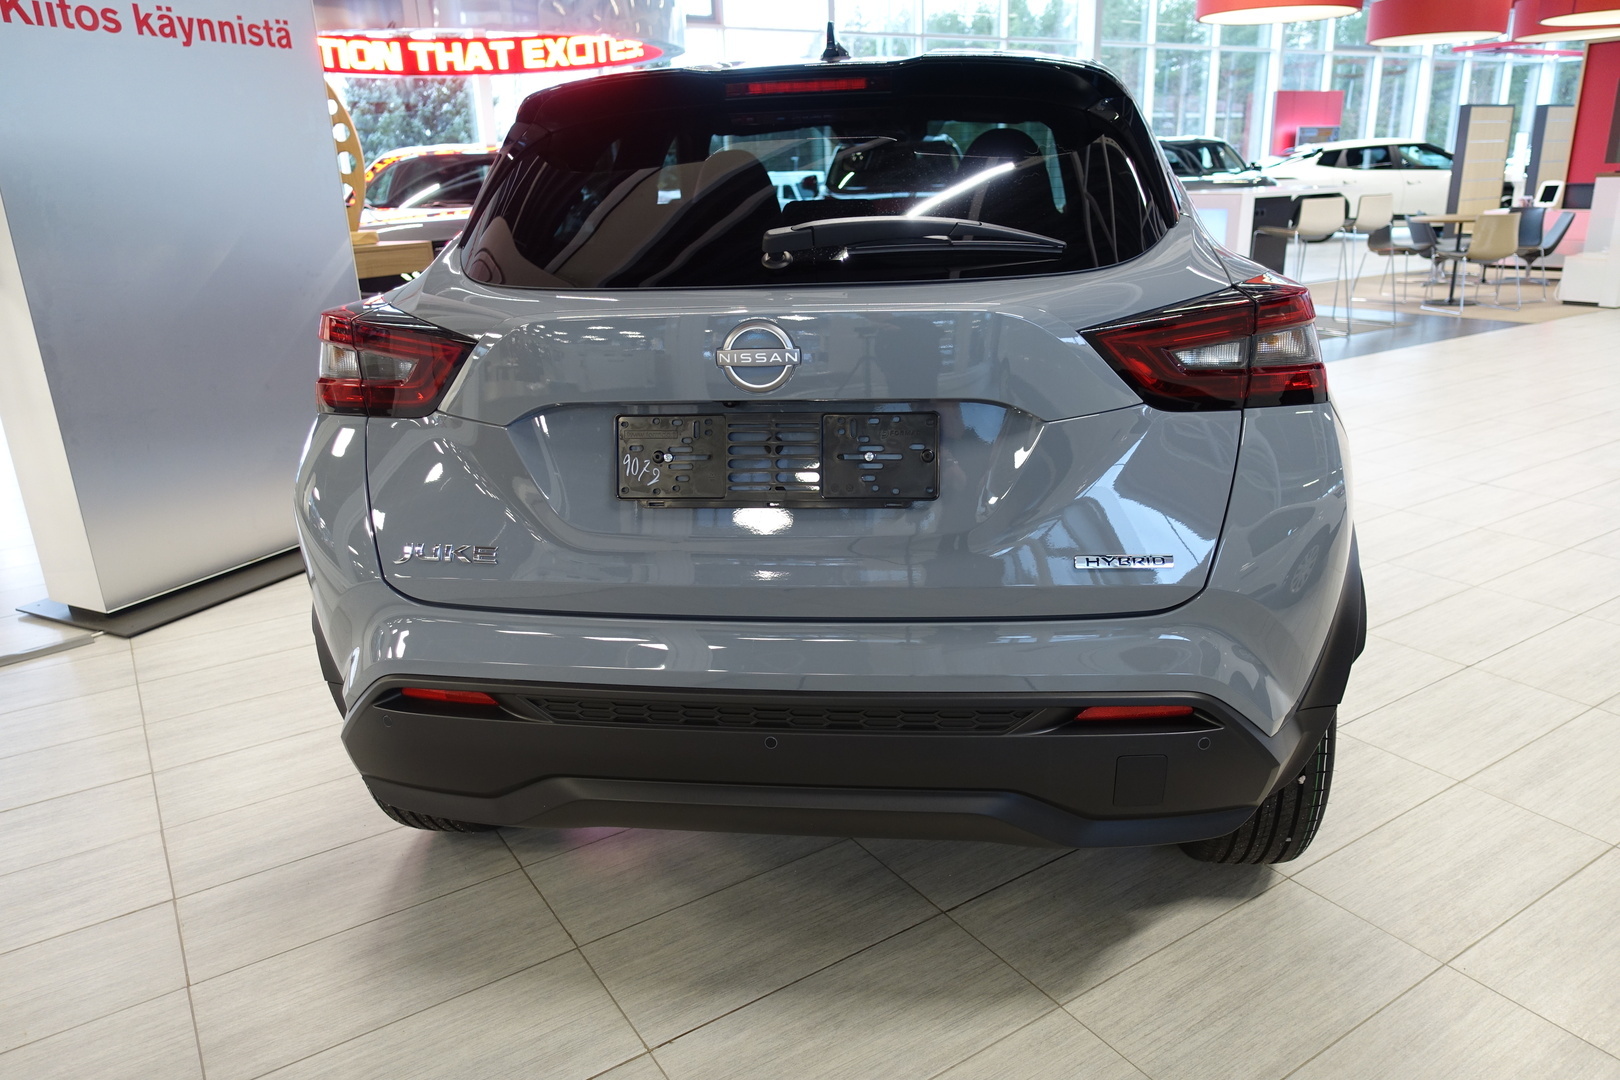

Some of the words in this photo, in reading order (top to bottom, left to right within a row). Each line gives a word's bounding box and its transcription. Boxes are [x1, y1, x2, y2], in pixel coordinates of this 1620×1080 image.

[0, 0, 122, 34] Kiitos
[131, 3, 293, 49] käynnistä
[407, 40, 516, 72] THAT
[719, 352, 798, 364] NISSAN
[392, 542, 499, 565] JUKE
[1085, 556, 1166, 568] HYBRID
